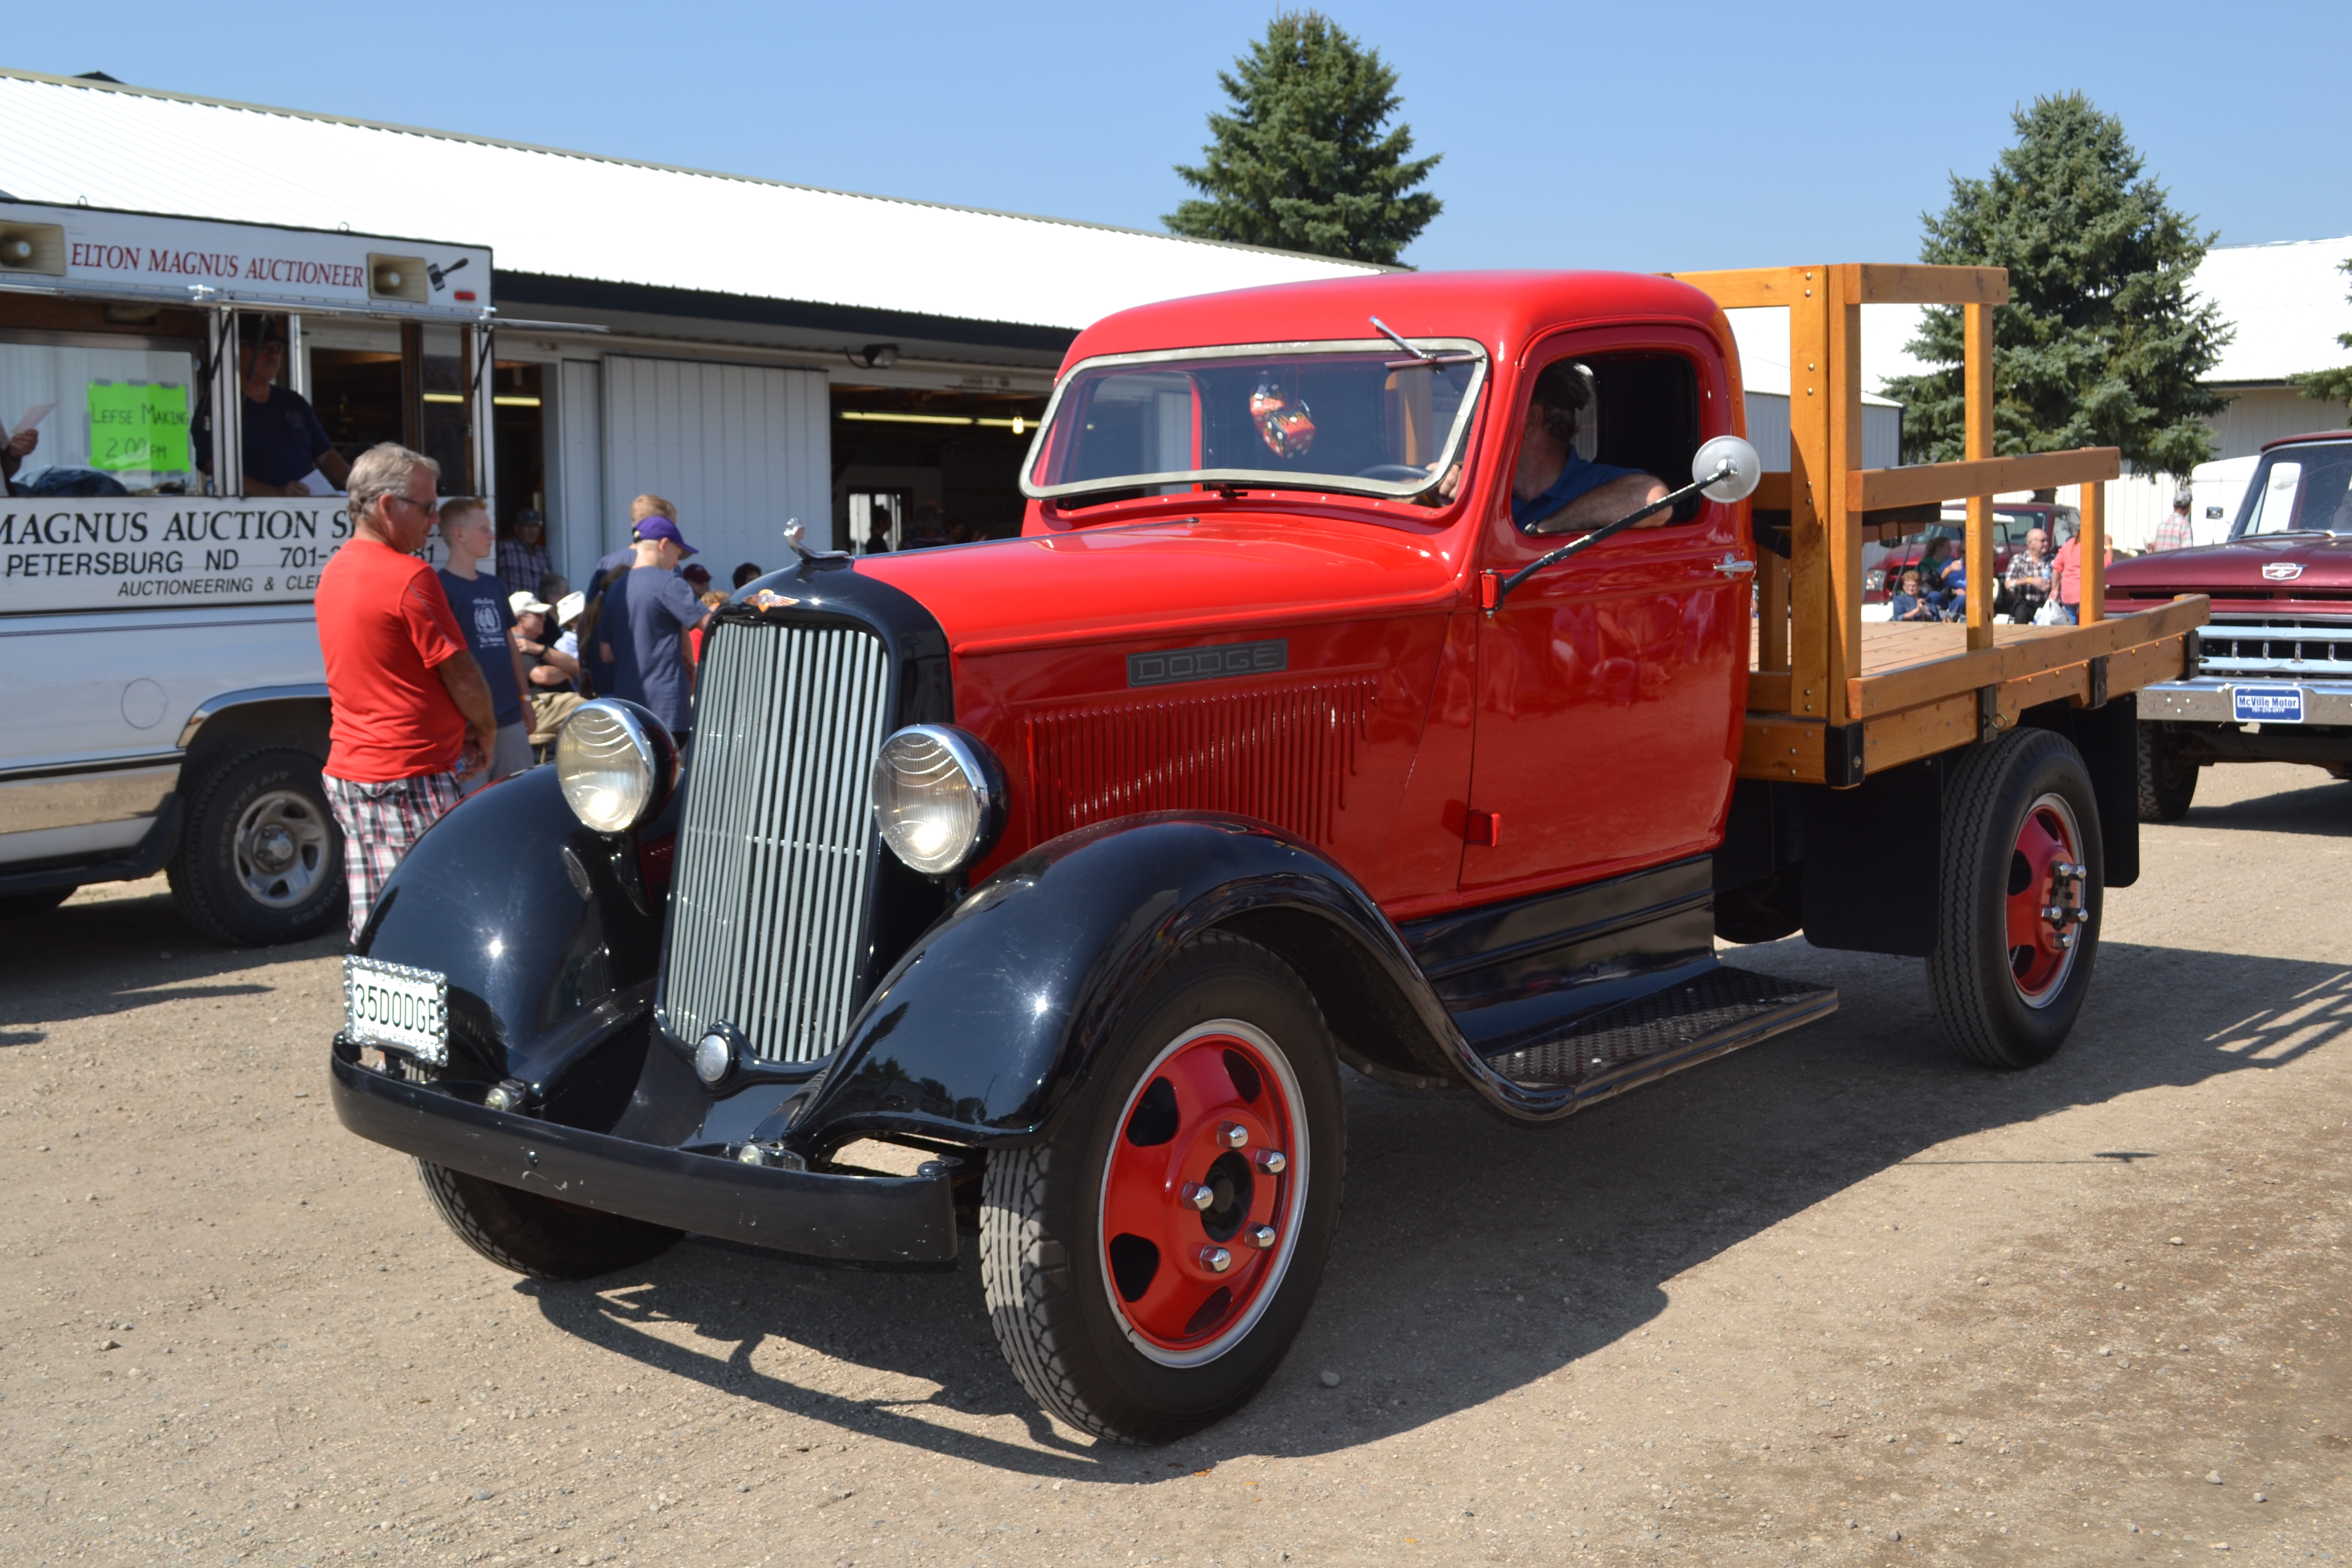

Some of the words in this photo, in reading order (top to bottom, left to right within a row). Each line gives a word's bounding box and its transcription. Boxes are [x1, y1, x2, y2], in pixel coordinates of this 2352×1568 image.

[71, 242, 140, 270] ELTON
[148, 248, 238, 277] MAGNUS
[245, 258, 364, 287] AUCTIONEER
[162, 509, 318, 541] AUCTION
[6, 550, 184, 577] PETERSBURG
[205, 549, 239, 571] ND
[118, 577, 253, 596] AUCTIONEERING
[264, 576, 275, 591] &
[1137, 647, 1279, 679] DODGE
[2239, 696, 2270, 707] McVille
[2271, 697, 2297, 707] Motor
[355, 983, 438, 1036] 35DODGE
